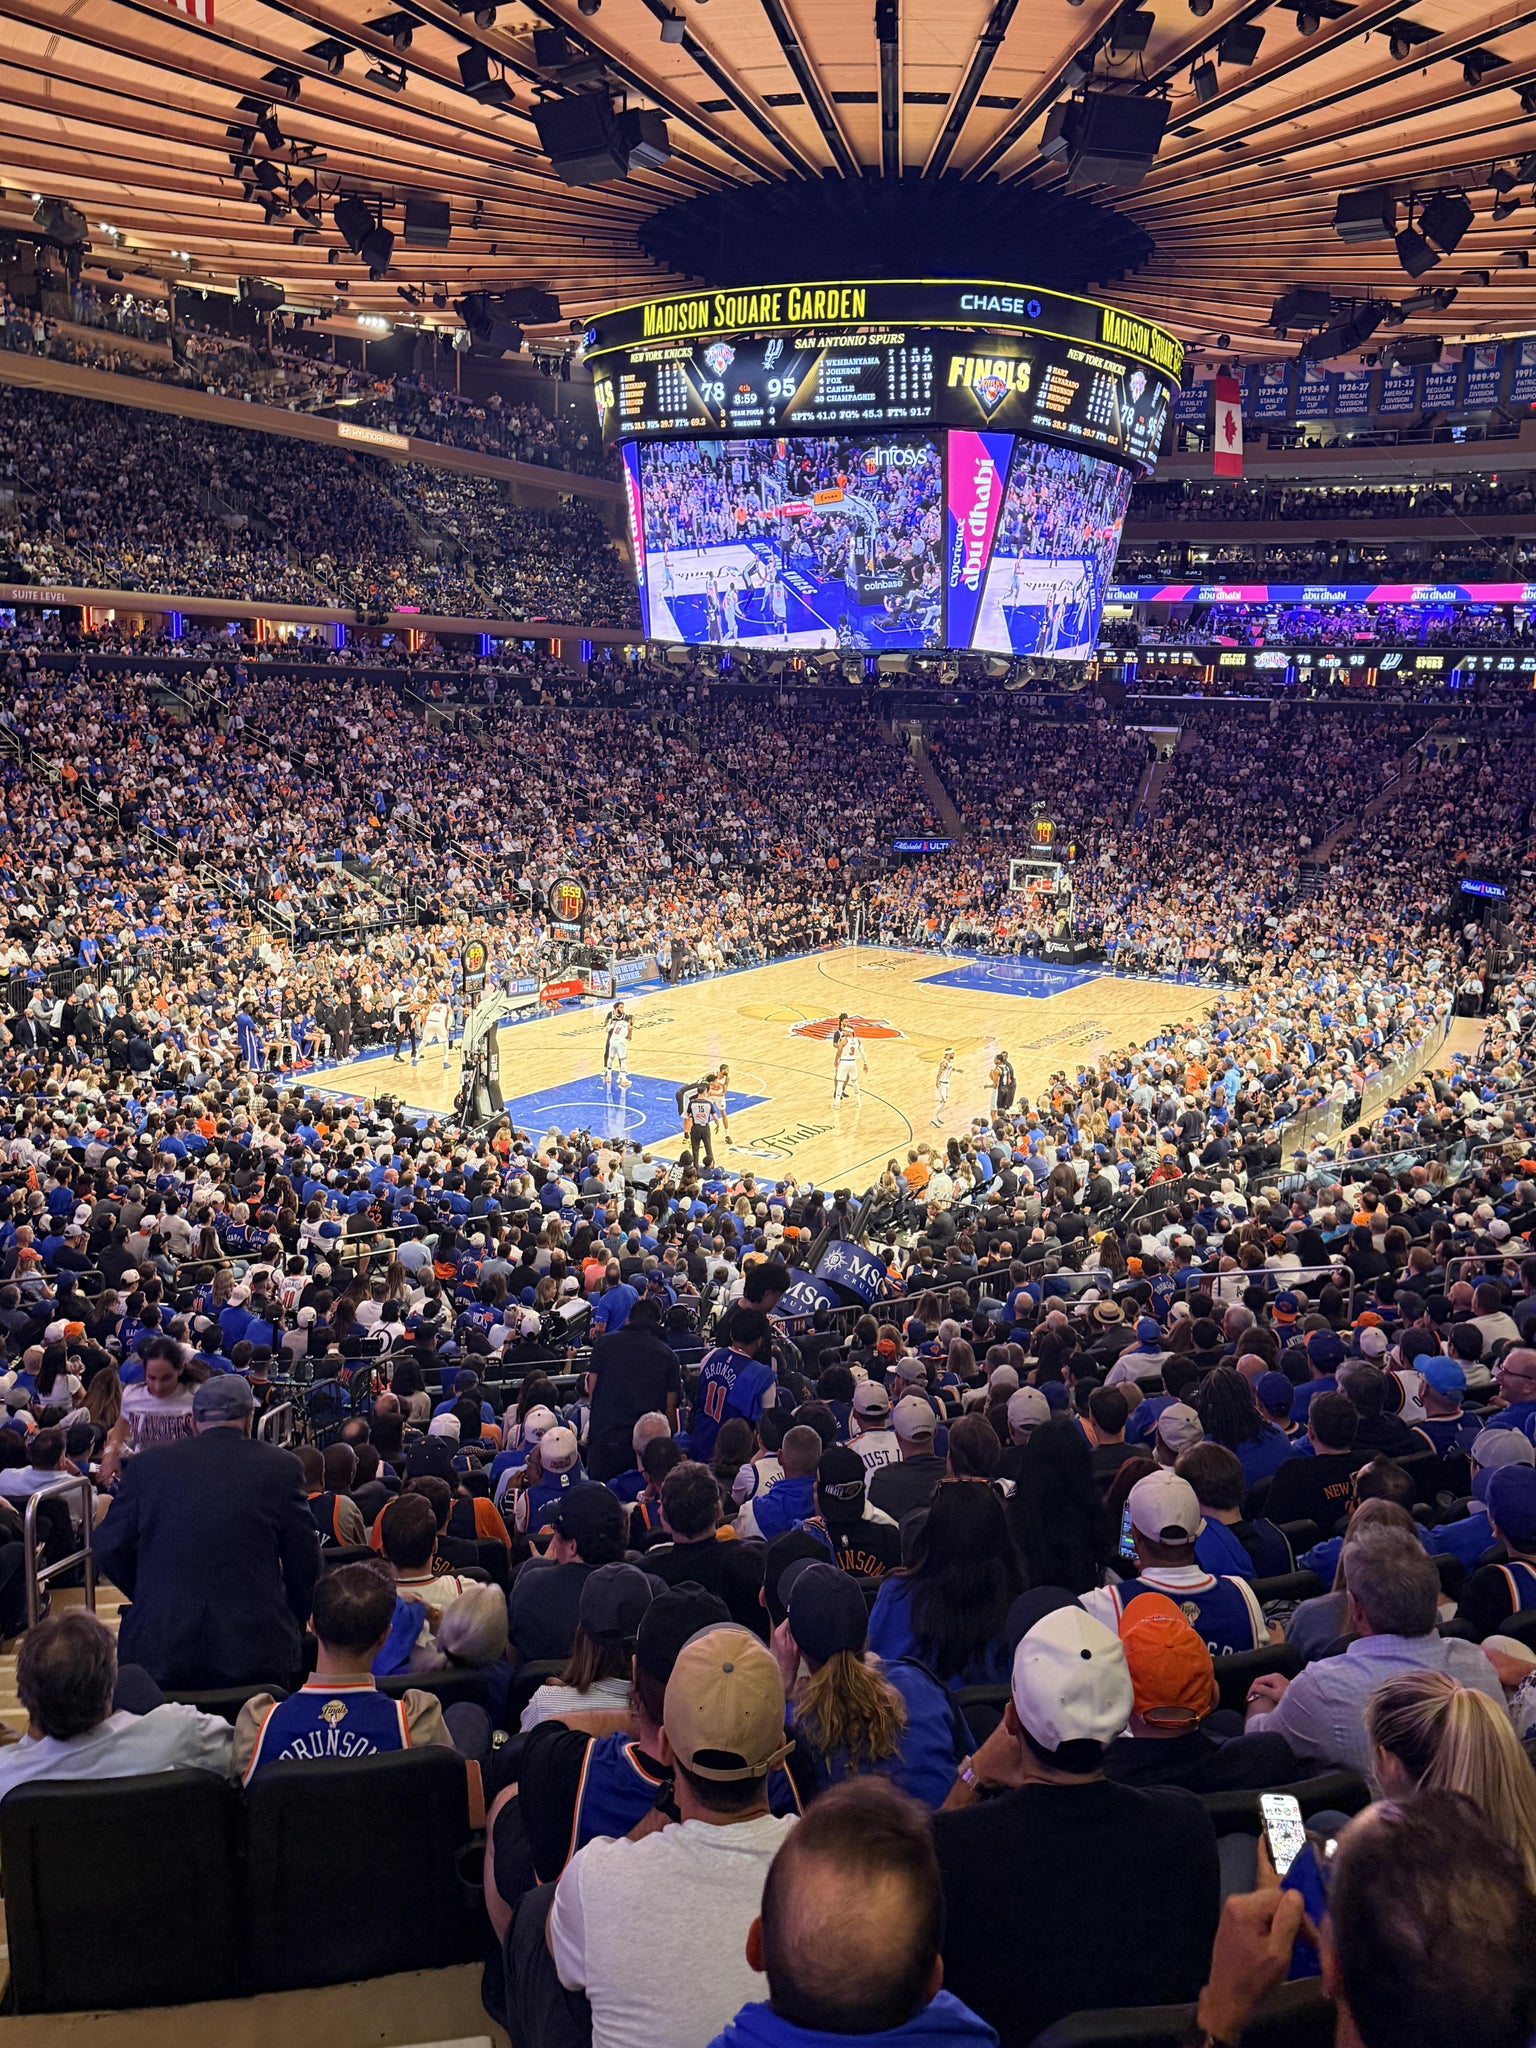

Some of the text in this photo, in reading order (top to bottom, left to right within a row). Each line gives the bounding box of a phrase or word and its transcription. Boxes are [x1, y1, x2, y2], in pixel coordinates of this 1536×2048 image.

[961, 294, 1024, 314] CHASE
[643, 287, 866, 337] MADISON SQUARE GARDEN
[1103, 309, 1150, 356] MADISON
[795, 332, 905, 349] SAN ANTONIO SPURS
[630, 347, 693, 364] NEW YORK KNICKS
[826, 357, 880, 366] WEMBANYAMA
[922, 354, 933, 362] 22
[1067, 349, 1127, 376] NEW YORK KNICKS
[826, 367, 861, 375] JOHNSON
[1052, 367, 1069, 377] HART
[826, 377, 842, 385] FOX
[1050, 375, 1080, 389] ALVARADO
[1426, 375, 1457, 385] 1941-42
[1467, 372, 1500, 382] 1989-90
[768, 378, 796, 398] 95
[826, 385, 855, 393] CASTLE
[1339, 382, 1369, 391] 1926-27
[1384, 379, 1415, 388] 1931-32
[701, 382, 725, 402] 78
[1179, 390, 1207, 398] 1927-28
[1258, 387, 1288, 396] 1939-40
[1299, 385, 1329, 394] 1993-94
[1384, 389, 1413, 397] AMERICAN
[1426, 386, 1454, 394] REGULAR
[734, 393, 757, 404] 8:59
[1421, 400, 1455, 408] CHAMPIONS
[1463, 396, 1498, 405] CHAMPIONS
[769, 406, 775, 415] 0
[1335, 405, 1368, 413] CHAMPIONS
[1380, 403, 1413, 411] CHAMPIONS
[817, 411, 836, 420] 41.0
[840, 410, 860, 419] FG%
[862, 409, 883, 418] 45.3
[887, 408, 907, 417] FT%
[909, 407, 931, 416] 91.7
[1121, 404, 1135, 425] 78
[1254, 410, 1286, 418] CHAMPIONS
[769, 417, 776, 425] 4
[1033, 415, 1052, 427] 3PT%
[1052, 420, 1067, 431] 38.5
[352, 429, 384, 441] HYUNDAI
[875, 446, 927, 468] Infosys
[950, 517, 965, 588] experience
[961, 540, 983, 591] abu
[864, 580, 903, 591] coinbase
[12, 589, 66, 602] SUITE LEVEL
[1302, 590, 1323, 600] abu
[1411, 590, 1433, 600] abu
[1298, 655, 1311, 664] 78
[1318, 658, 1341, 667] 8:59
[1350, 655, 1365, 665] 95
[1416, 660, 1443, 669] SPURS
[929, 842, 948, 850] ULT
[562, 886, 581, 898] 8:59
[849, 1046, 855, 1055] 3
[697, 1105, 705, 1114] 15
[750, 1122, 836, 1158] Finals
[283, 1291, 295, 1308] 11
[704, 1363, 738, 1389] BRUNSO
[703, 1381, 728, 1423] 11
[863, 1449, 890, 1469] UST
[1323, 1483, 1348, 1500] NEW
[836, 1549, 886, 1577] UNSON
[321, 1704, 348, 1716] Finals
[279, 1729, 380, 1761] RUNSO
